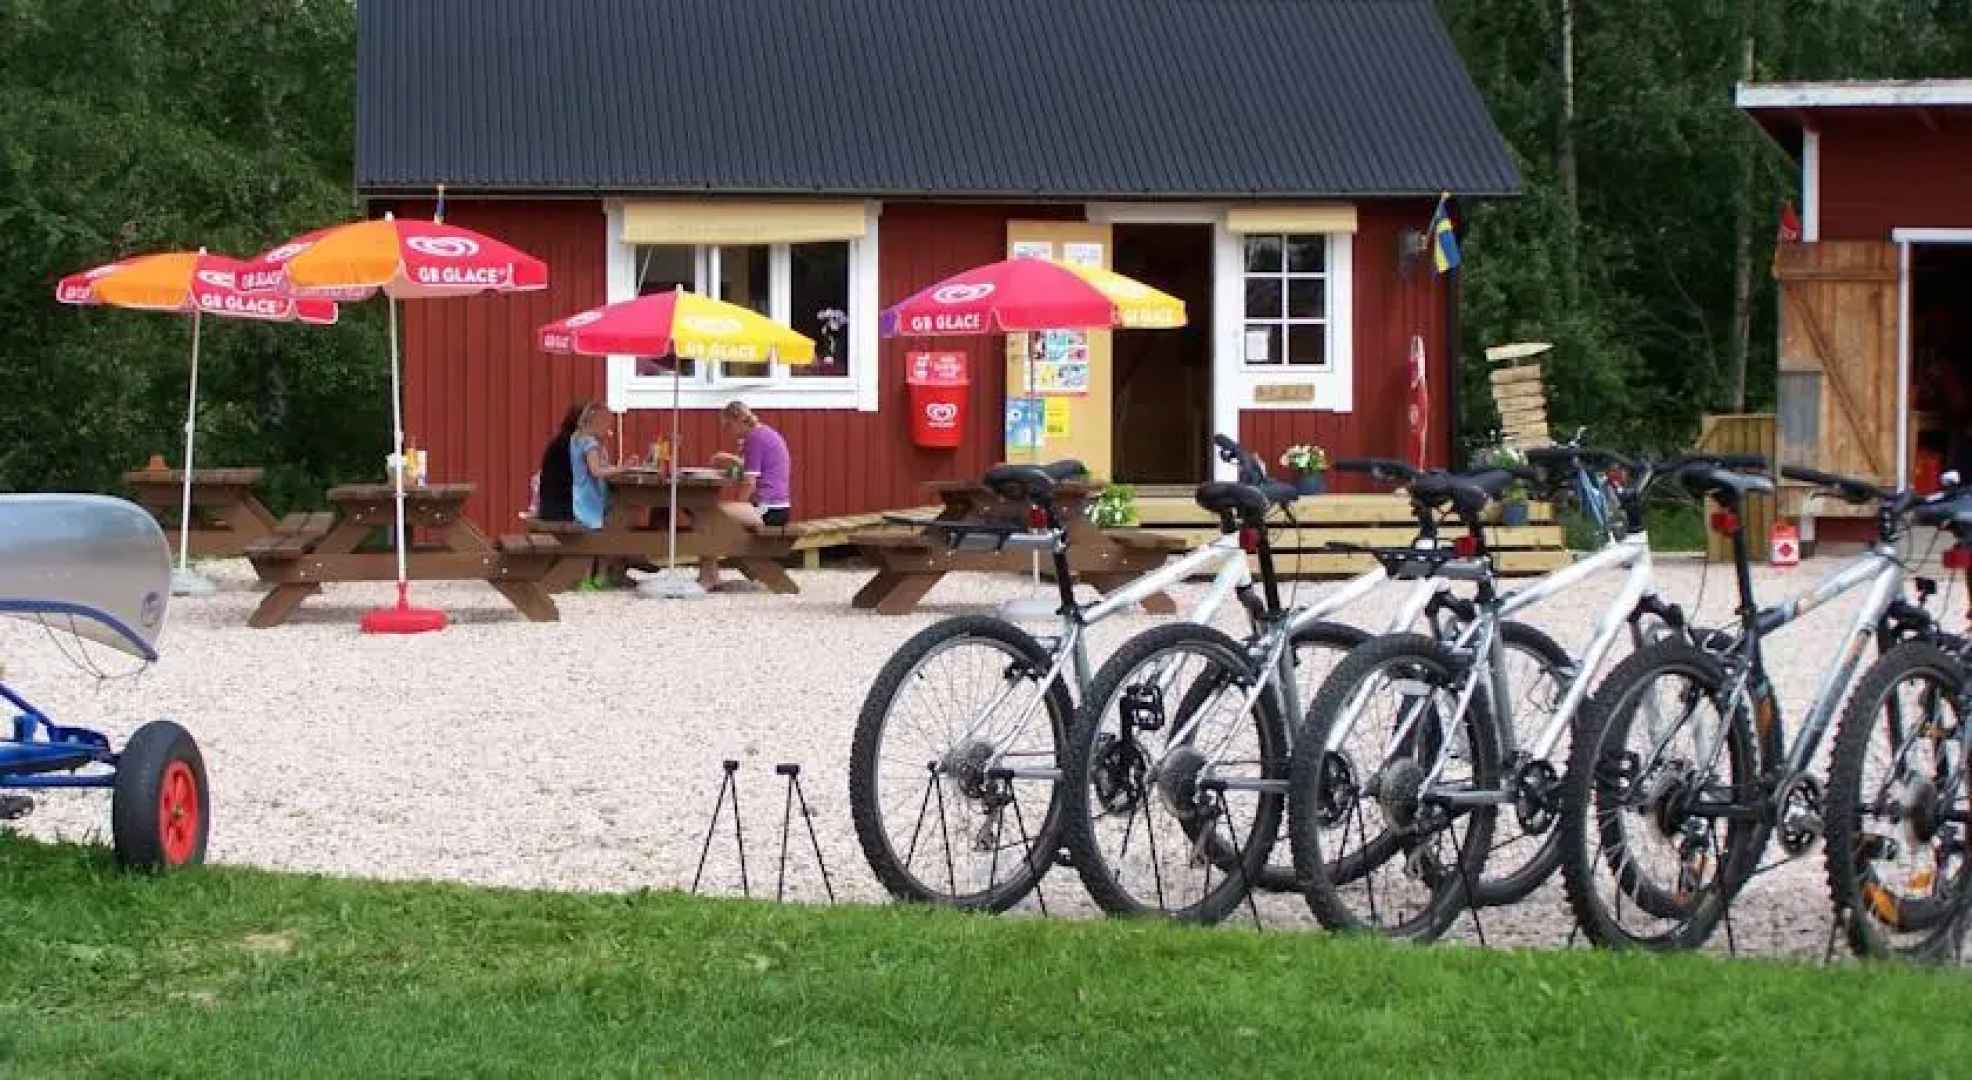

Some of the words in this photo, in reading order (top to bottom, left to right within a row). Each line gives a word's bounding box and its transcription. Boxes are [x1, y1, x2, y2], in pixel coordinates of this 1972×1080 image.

[418, 266, 440, 283] GB
[443, 266, 499, 283] GLACE
[201, 293, 222, 311] GB
[224, 295, 277, 314] GLACE
[912, 315, 932, 330] GB
[936, 313, 980, 330] GLACE
